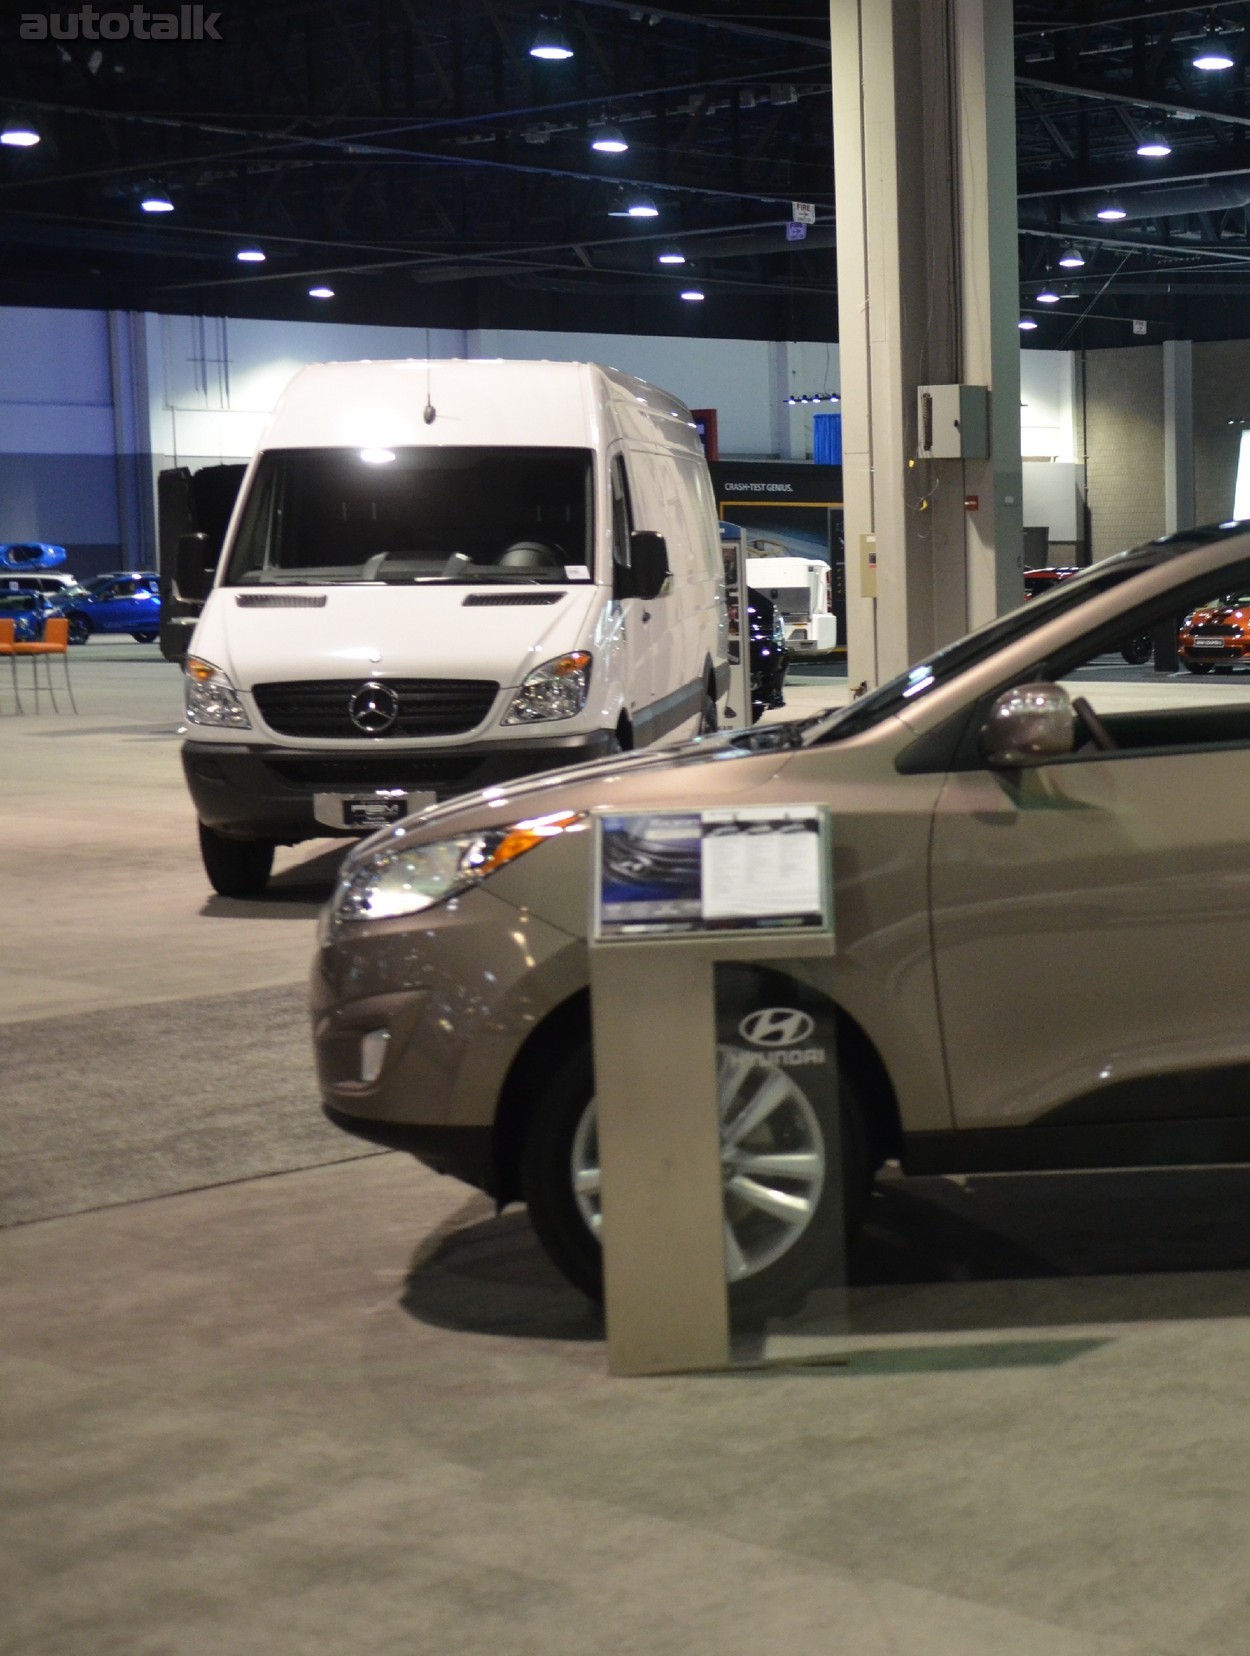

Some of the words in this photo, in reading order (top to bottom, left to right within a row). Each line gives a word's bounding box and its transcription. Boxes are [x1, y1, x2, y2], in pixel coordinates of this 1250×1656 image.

[797, 203, 810, 211] FIRE
[724, 482, 765, 491] CRASH-TEST
[766, 483, 794, 492] GENIUS.
